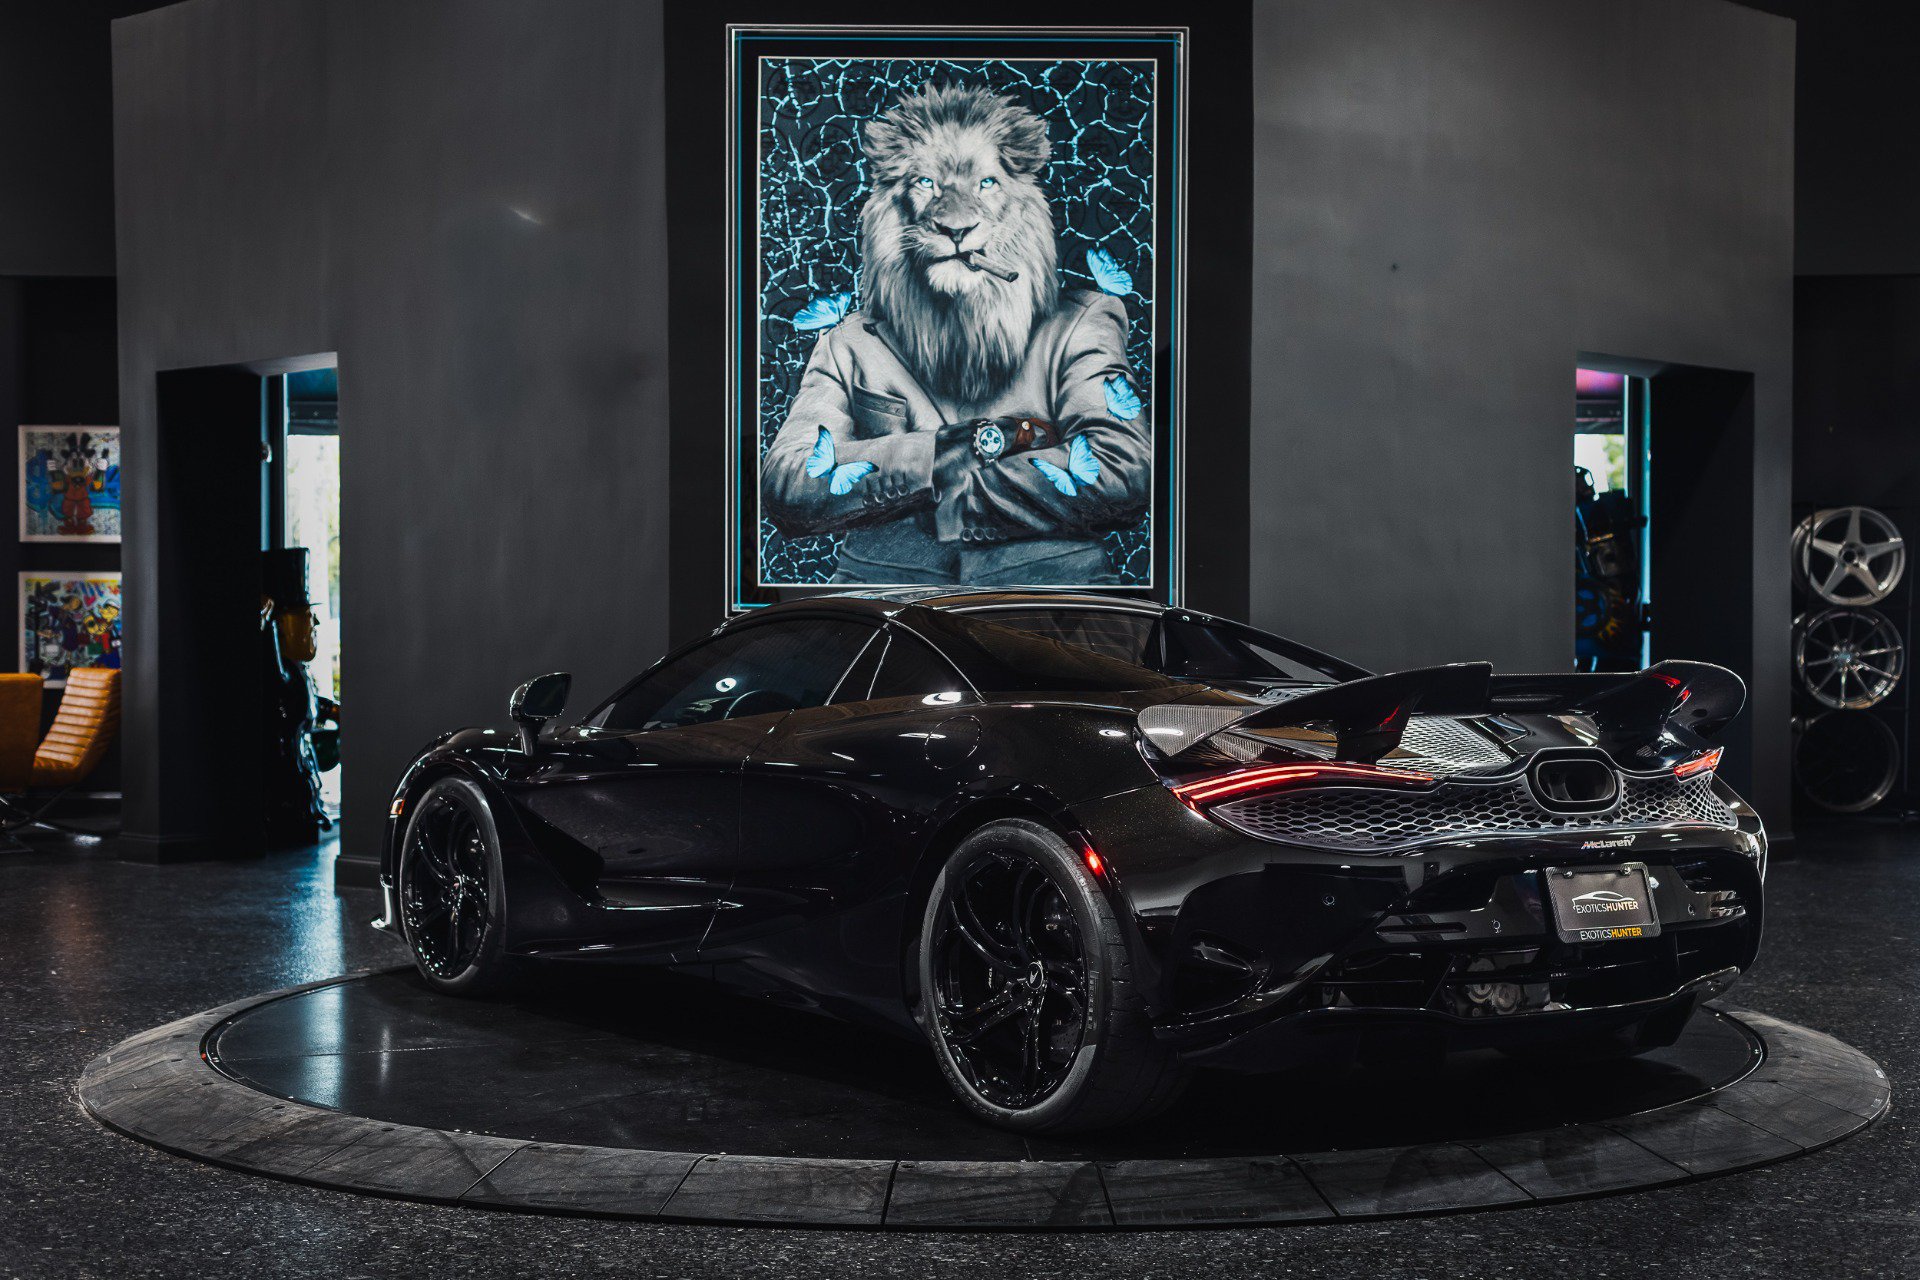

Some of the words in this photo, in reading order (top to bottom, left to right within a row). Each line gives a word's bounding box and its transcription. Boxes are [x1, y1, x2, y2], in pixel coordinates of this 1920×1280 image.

[1581, 837, 1633, 850] McLaren
[1576, 901, 1639, 914] EXOTICSHUNTER
[1580, 927, 1643, 941] EXOTICSHUNTER
